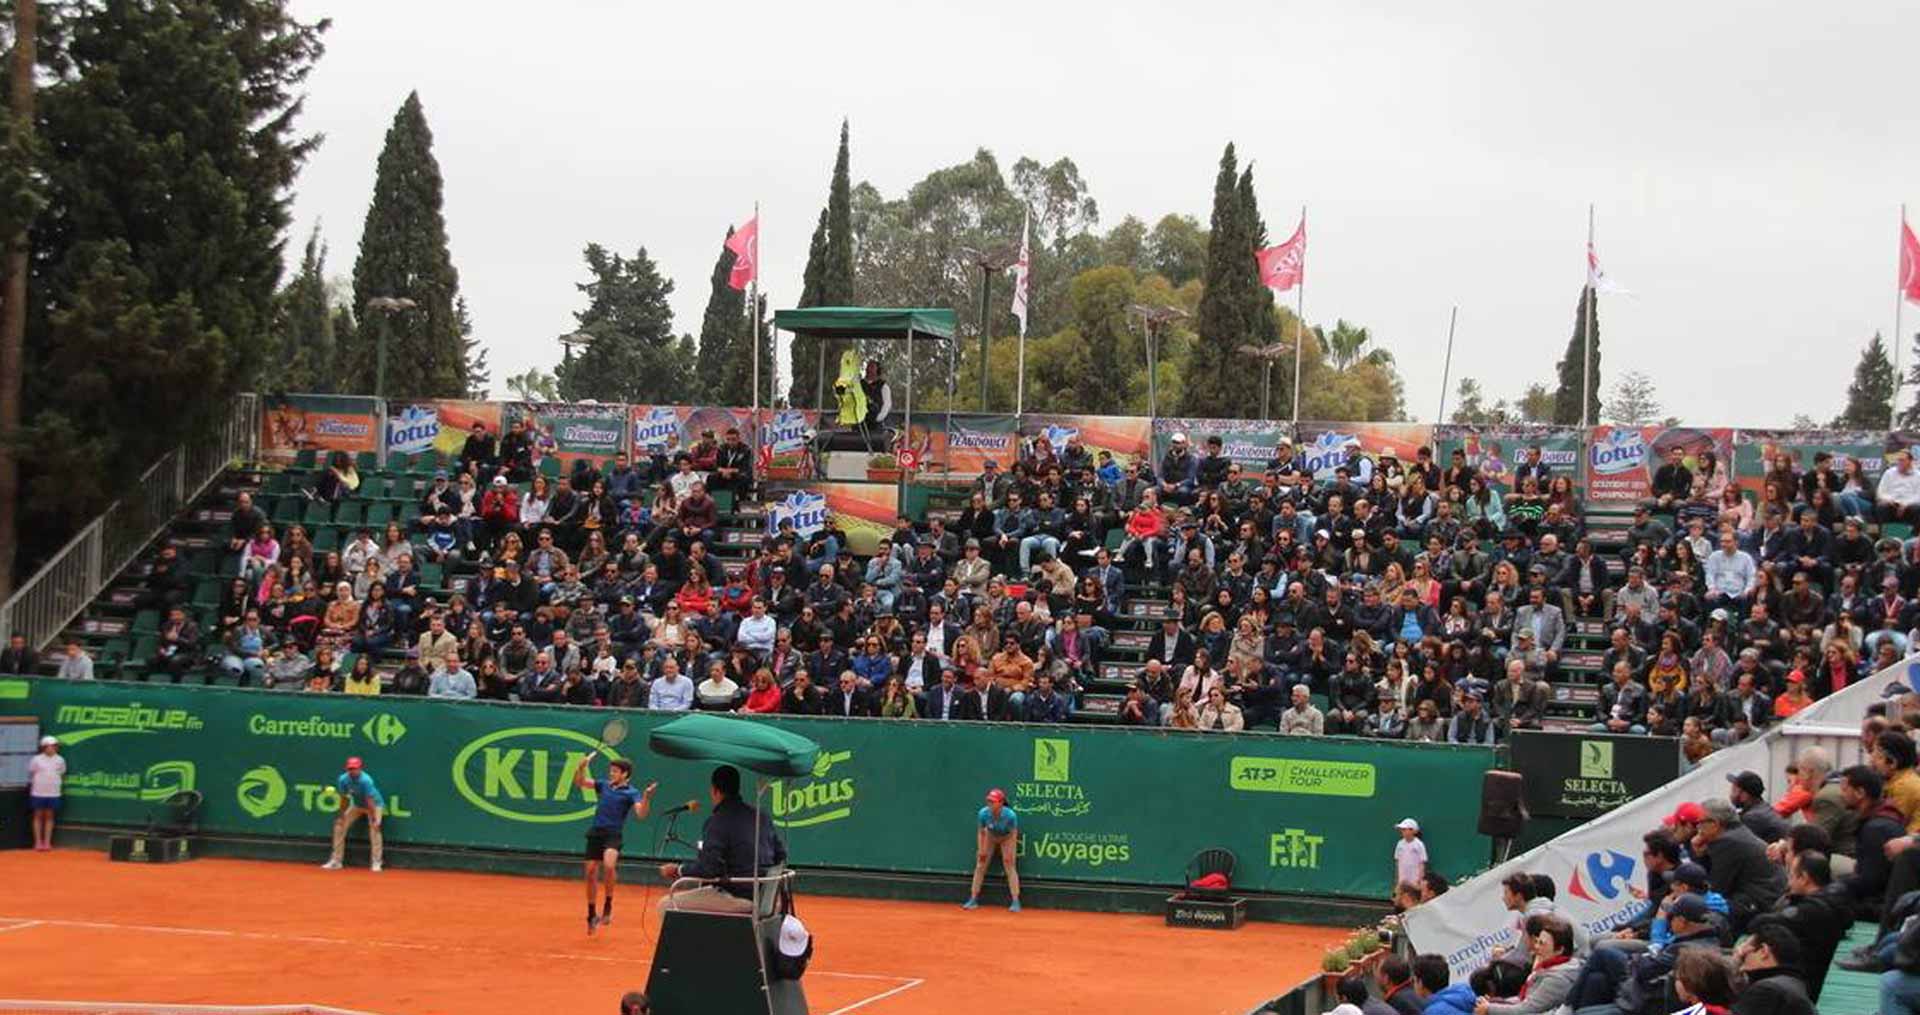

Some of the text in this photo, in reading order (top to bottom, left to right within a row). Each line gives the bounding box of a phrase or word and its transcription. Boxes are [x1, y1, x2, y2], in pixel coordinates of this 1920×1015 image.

[1302, 448, 1347, 470] lotu
[1590, 443, 1644, 466] lotus
[769, 508, 829, 535] ltus
[56, 701, 188, 730] mosaïque
[249, 714, 355, 738] Carrefour
[483, 747, 598, 803] KIA
[1290, 766, 1370, 780] CHALLENGER
[1290, 776, 1322, 787] TOUR
[770, 778, 855, 816] lotus
[1016, 783, 1084, 799] SELECTA
[1564, 778, 1627, 794] SELECTA
[295, 784, 412, 817] TOL
[1448, 928, 1512, 966] arrefour
